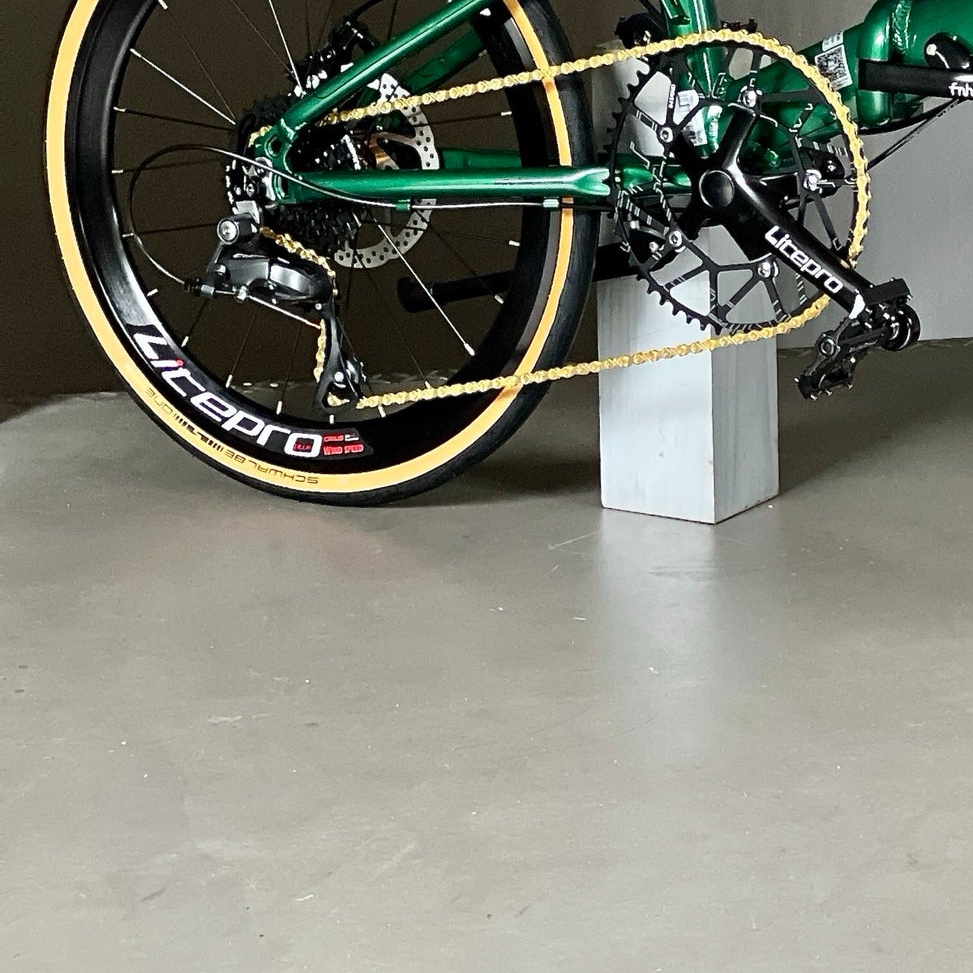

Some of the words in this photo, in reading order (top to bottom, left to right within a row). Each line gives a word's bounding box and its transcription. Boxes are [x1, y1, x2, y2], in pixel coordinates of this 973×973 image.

[764, 225, 844, 293] Litepro
[132, 332, 323, 458] Litepro
[223, 449, 319, 485] SCHWALBE
